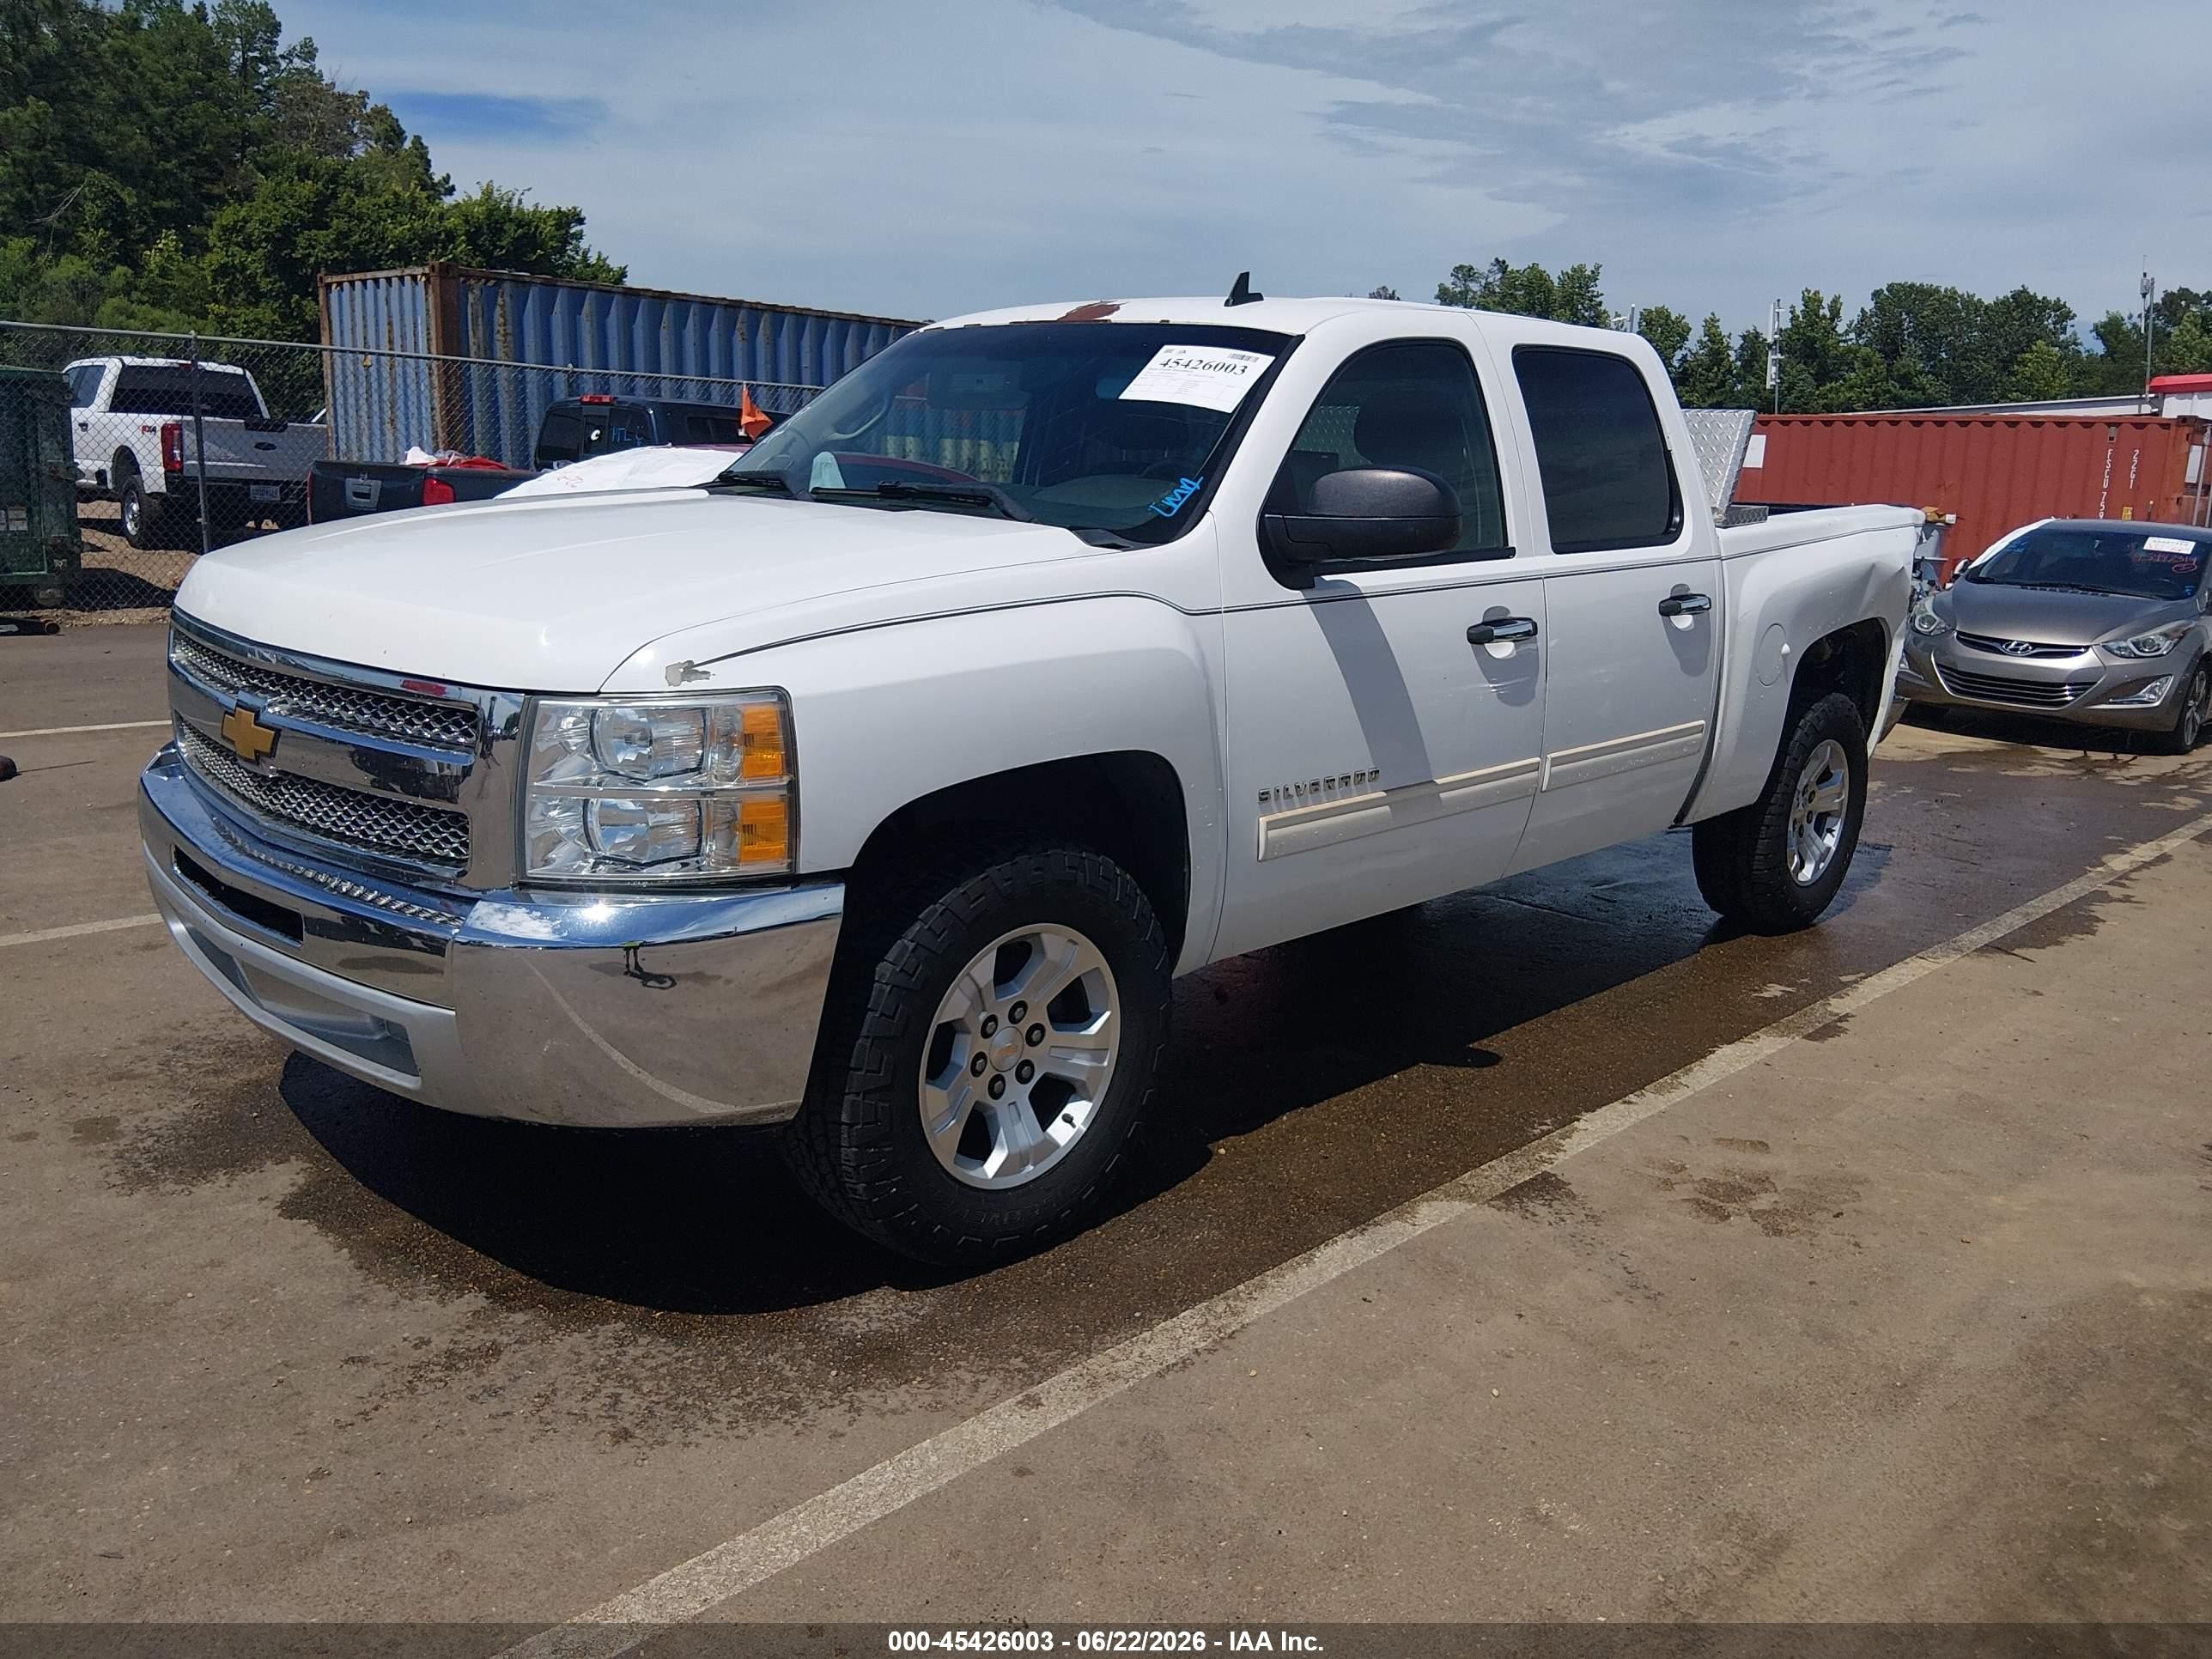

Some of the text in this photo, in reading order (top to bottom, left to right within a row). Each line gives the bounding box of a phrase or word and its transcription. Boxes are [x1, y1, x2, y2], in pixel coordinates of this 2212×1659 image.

[1159, 349, 1248, 376] 45426003
[2103, 448, 2113, 489] FSCU
[2130, 449, 2140, 489] 22G1
[1258, 768, 1380, 802] SILVERADO
